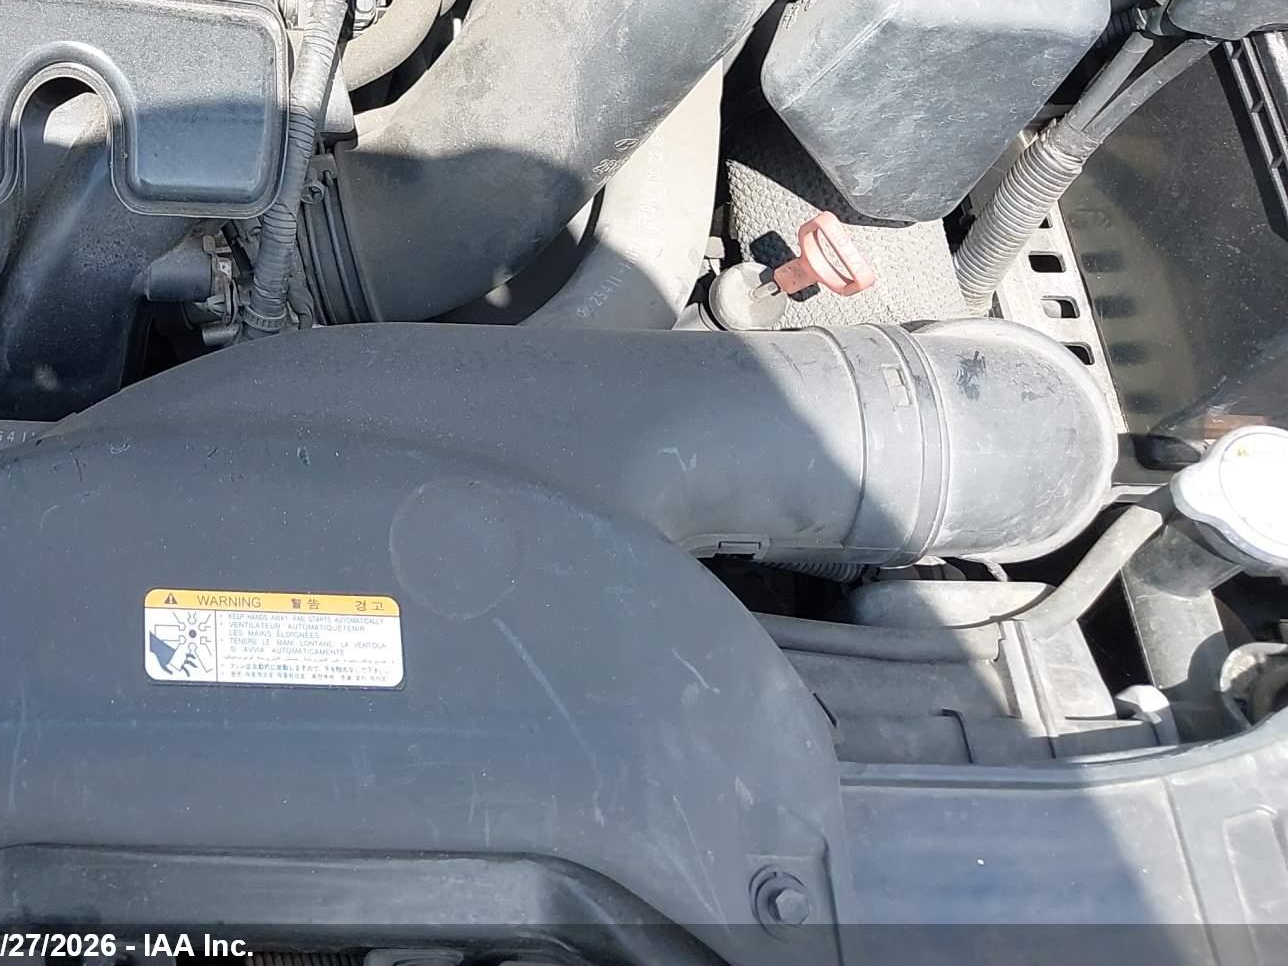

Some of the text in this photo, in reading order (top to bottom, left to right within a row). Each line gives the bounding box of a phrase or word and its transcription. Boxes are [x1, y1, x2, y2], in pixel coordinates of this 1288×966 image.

[197, 595, 262, 609] WARNING
[229, 621, 281, 630] VENTILATEUR
[271, 646, 345, 656] AUTOMATICAMENTE
